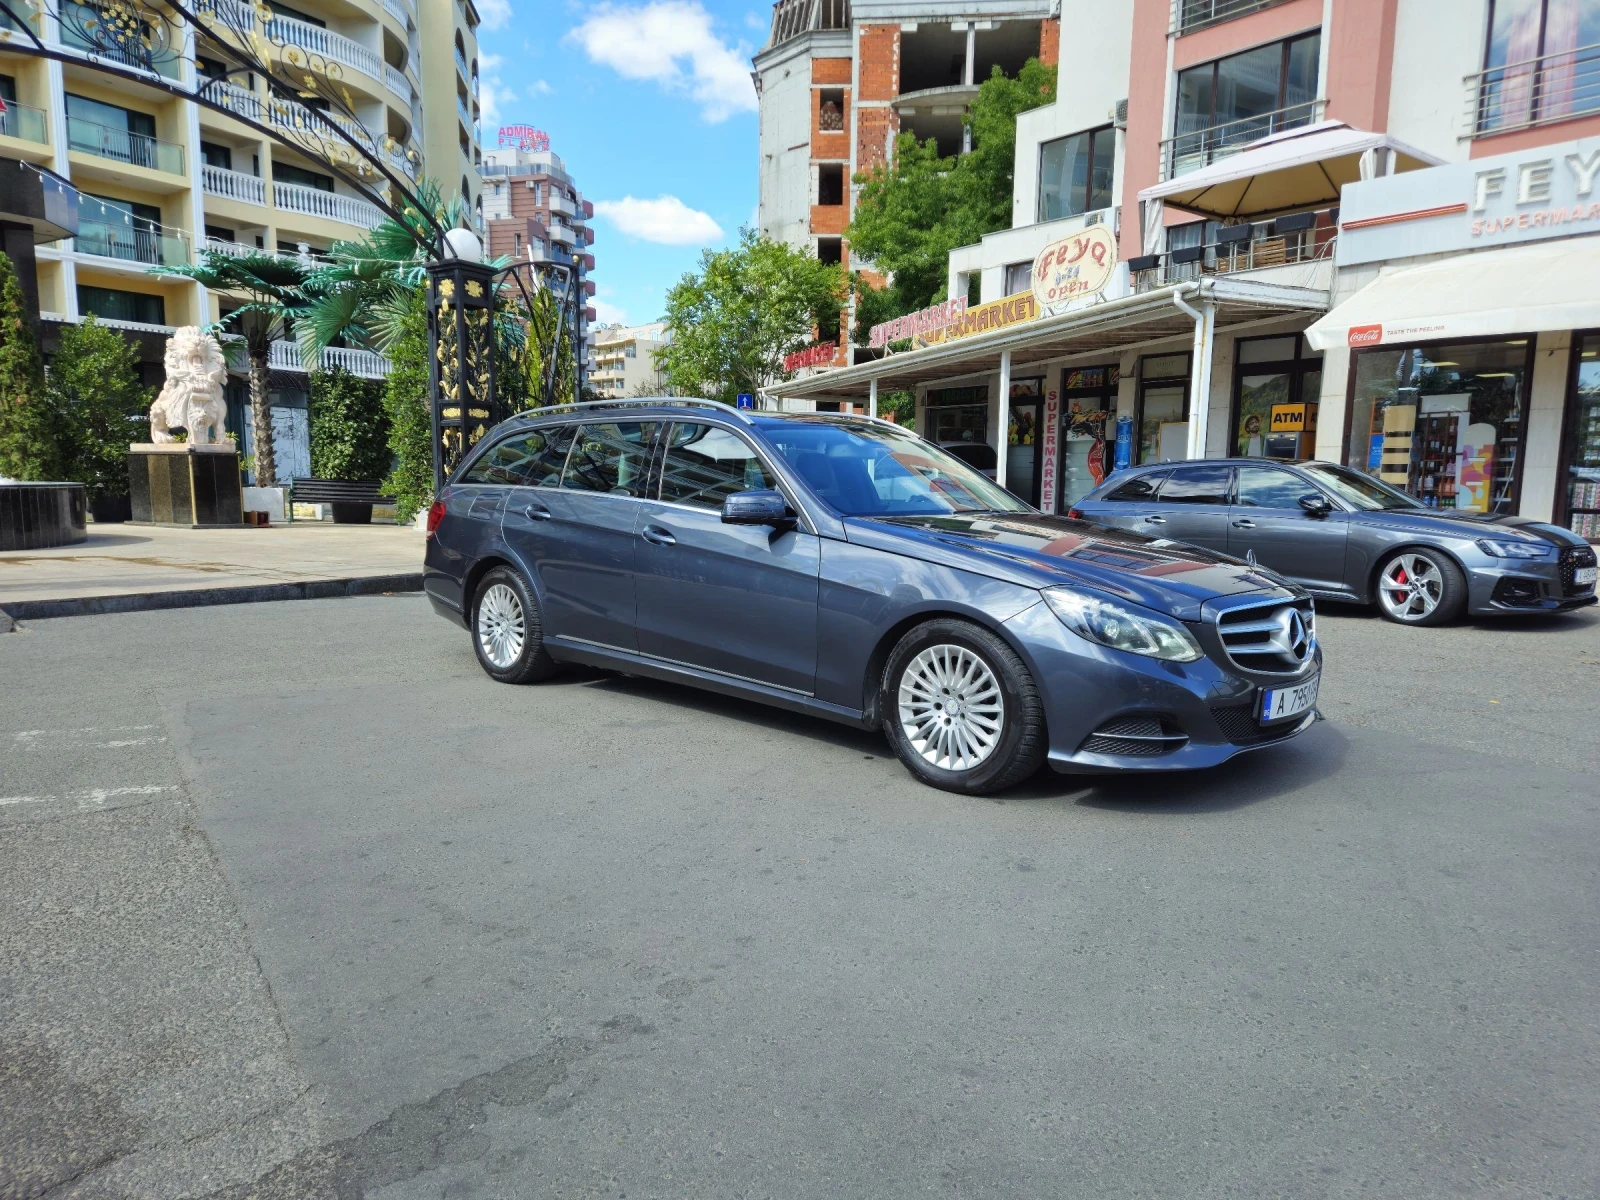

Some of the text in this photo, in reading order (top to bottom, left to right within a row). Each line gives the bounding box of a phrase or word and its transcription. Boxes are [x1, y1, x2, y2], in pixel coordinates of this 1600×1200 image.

[498, 126, 549, 141] ADMIRAL
[1473, 149, 1600, 212] FEY
[868, 295, 968, 348] SUPERMARKET
[919, 295, 1035, 343] UPERMARKET
[1419, 325, 1445, 333] FEELING
[1273, 412, 1303, 423] ATM
[1043, 391, 1057, 511] SUPERMARKET
[1276, 692, 1285, 715] A
